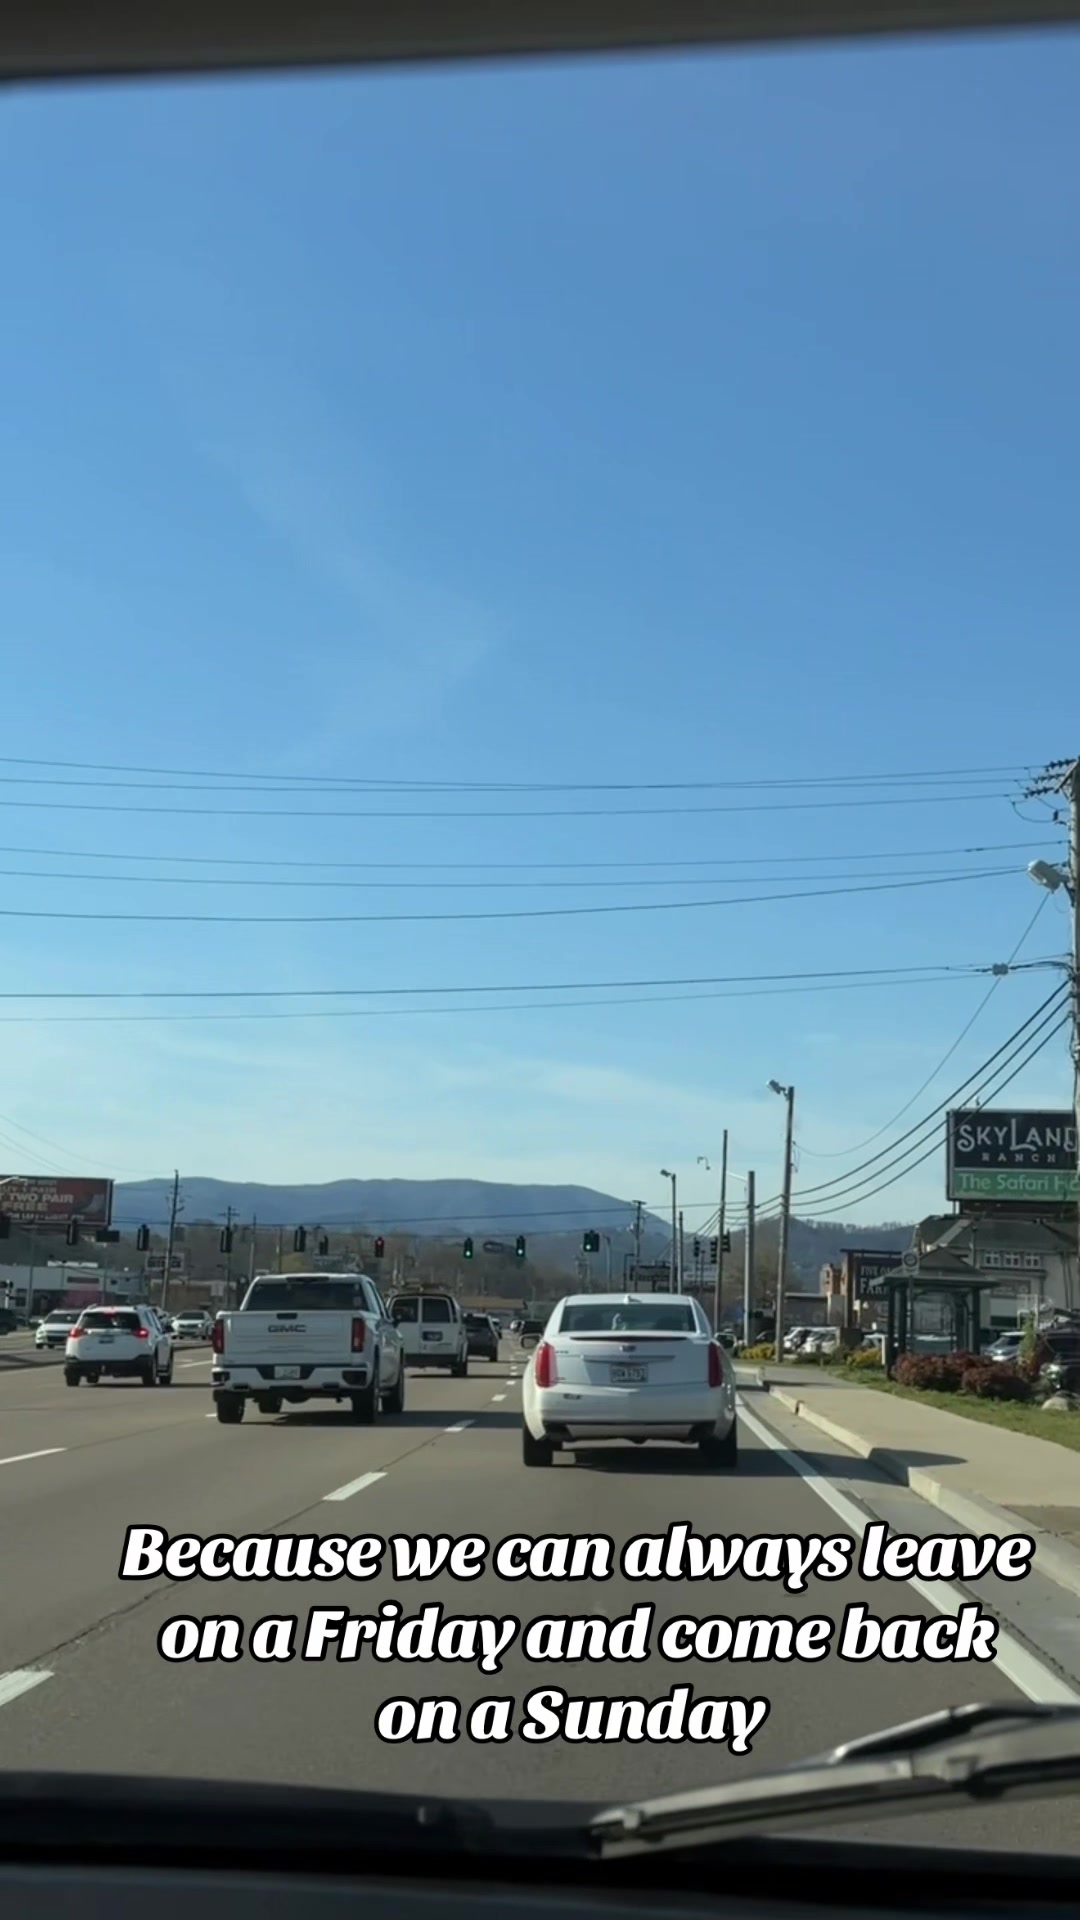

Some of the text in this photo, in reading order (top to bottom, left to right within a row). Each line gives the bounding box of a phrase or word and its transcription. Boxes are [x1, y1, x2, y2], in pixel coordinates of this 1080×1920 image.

[957, 1118, 1078, 1152] SKYLAND
[981, 1152, 1056, 1162] RANCH
[958, 1173, 992, 1190] The
[996, 1174, 1049, 1191] Safari
[9, 1193, 39, 1202] TWO
[42, 1194, 74, 1203] PAIR
[2, 1202, 48, 1212] FREE
[268, 1324, 307, 1333] GMC
